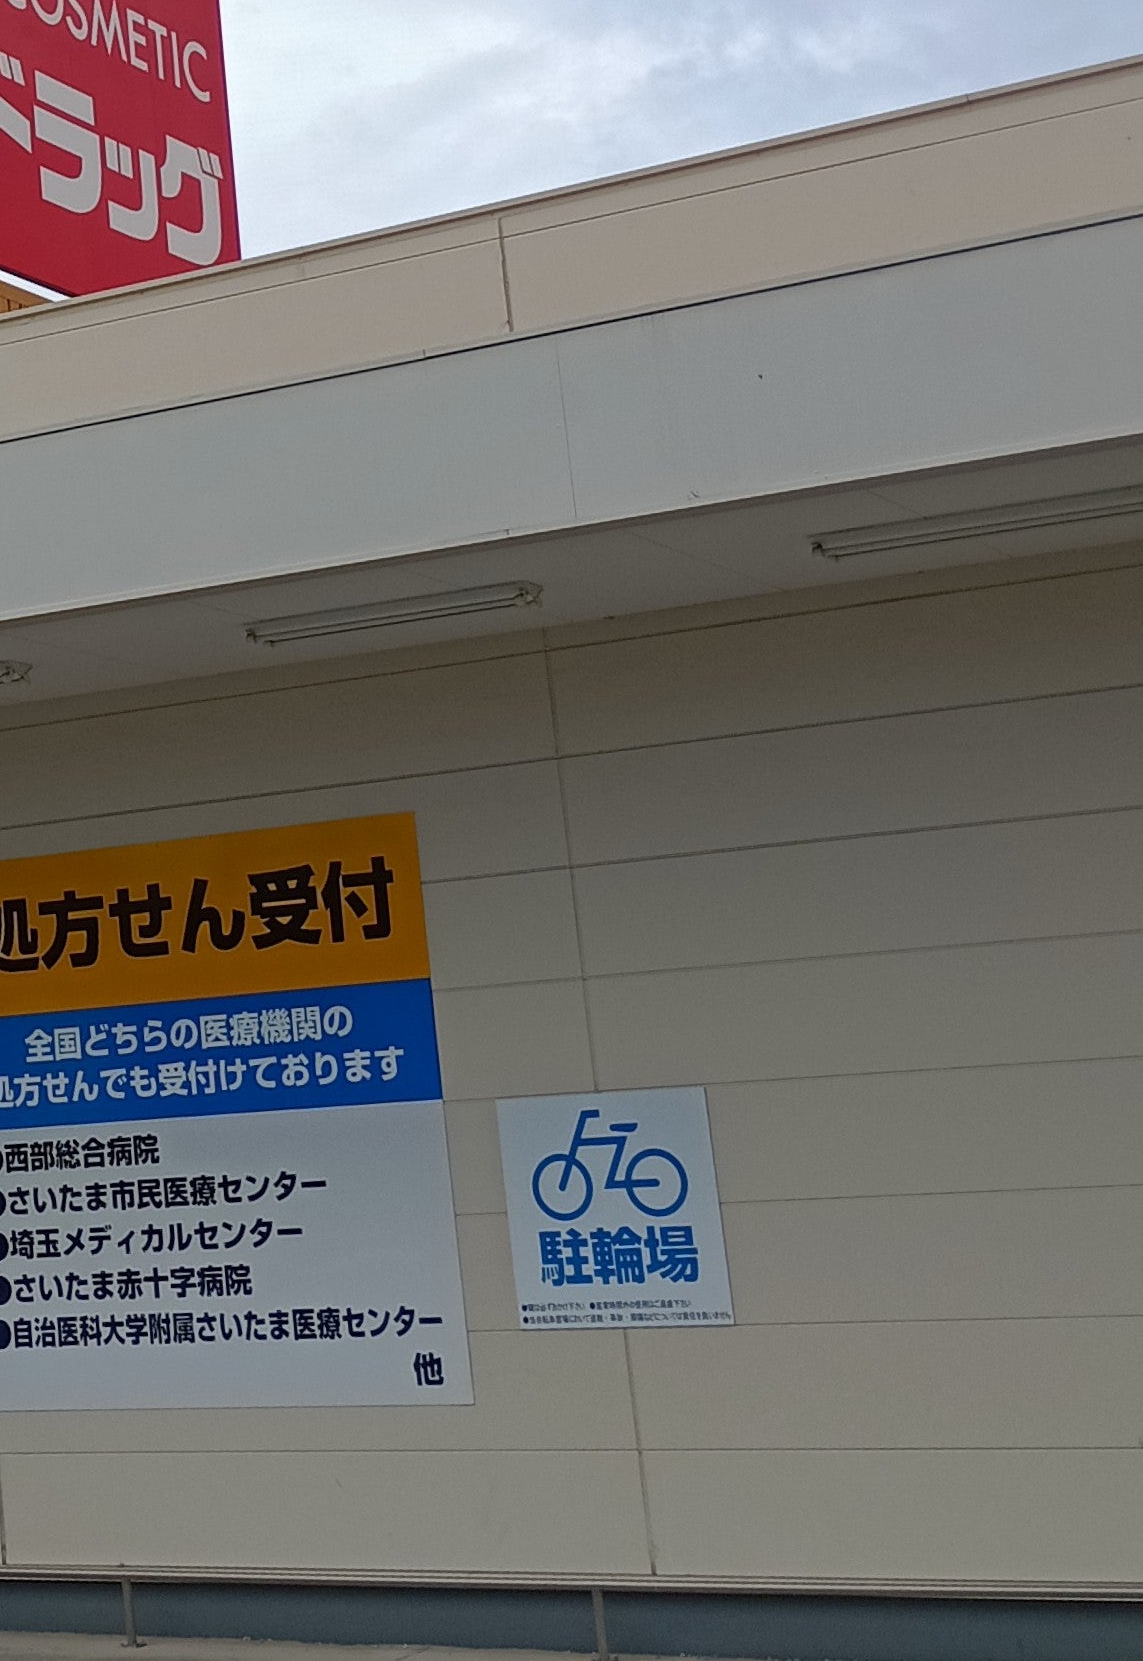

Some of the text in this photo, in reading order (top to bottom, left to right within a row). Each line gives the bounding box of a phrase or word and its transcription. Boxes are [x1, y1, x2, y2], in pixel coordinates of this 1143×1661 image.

[24, 1005, 354, 1064] 全国どちらの医療機関の
[538, 1225, 699, 1287] 駐輪場
[413, 1351, 445, 1387] 他
